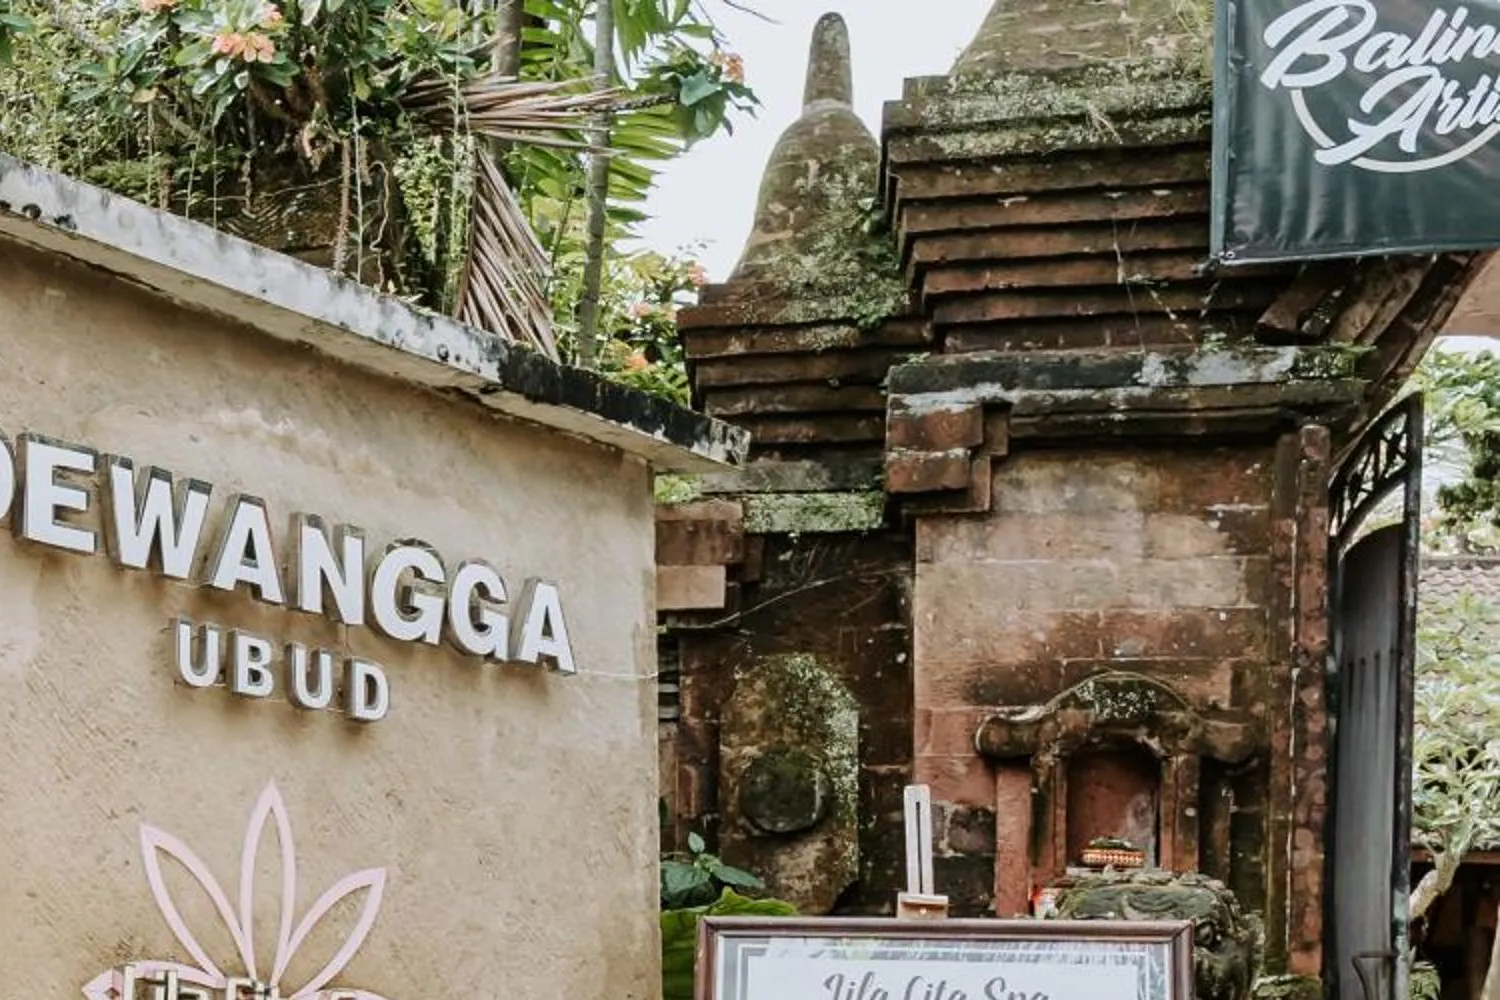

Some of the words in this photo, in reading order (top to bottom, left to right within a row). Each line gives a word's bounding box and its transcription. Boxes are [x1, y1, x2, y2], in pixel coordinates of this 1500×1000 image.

[1260, 0, 1500, 89] Balin
[1315, 65, 1500, 165] Arti
[172, 616, 390, 724] UBUD
